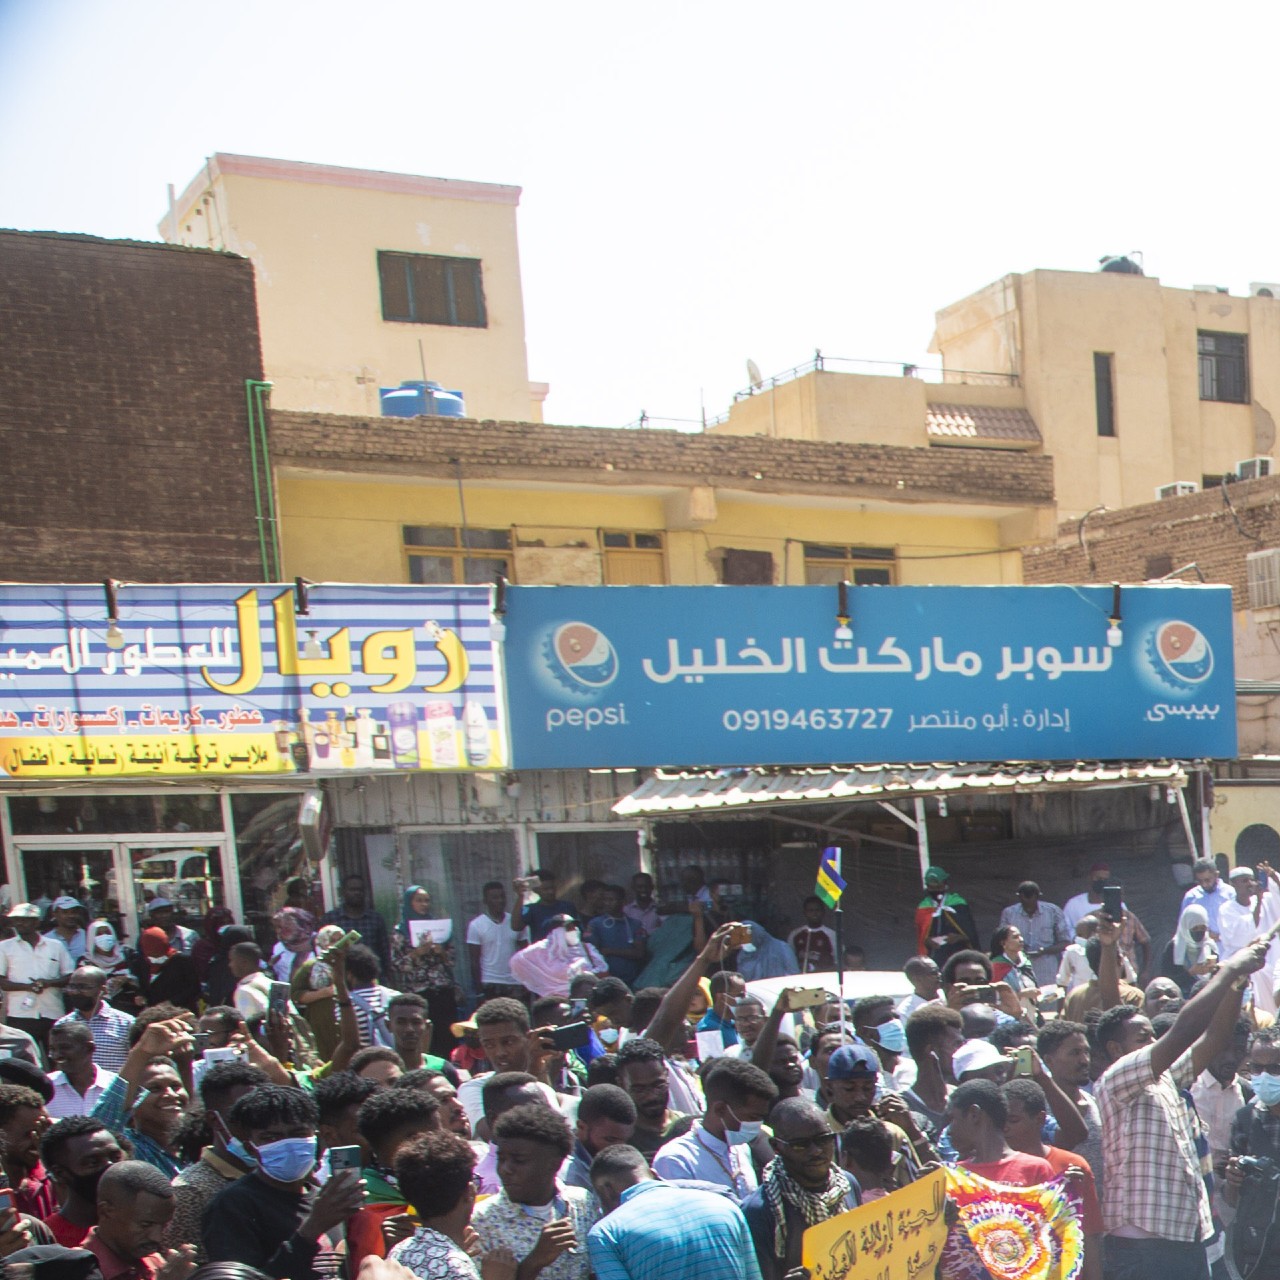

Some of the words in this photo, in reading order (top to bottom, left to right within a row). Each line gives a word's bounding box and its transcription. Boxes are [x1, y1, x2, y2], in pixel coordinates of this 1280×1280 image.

[101, 626, 234, 677] للعطور
[641, 636, 807, 684] الخليل
[818, 636, 983, 681] ماركت
[995, 643, 1113, 681] سوبر
[139, 703, 202, 733] كريمات
[217, 703, 264, 731] عطور
[545, 702, 626, 732] pepsi
[722, 708, 894, 732] 0919463727
[907, 709, 977, 733] منتصر
[982, 703, 1009, 732] أبو
[1022, 707, 1071, 733] إدارة
[127, 742, 169, 770] أنيقة
[171, 743, 218, 770] تركية
[223, 744, 269, 769] ملابس
